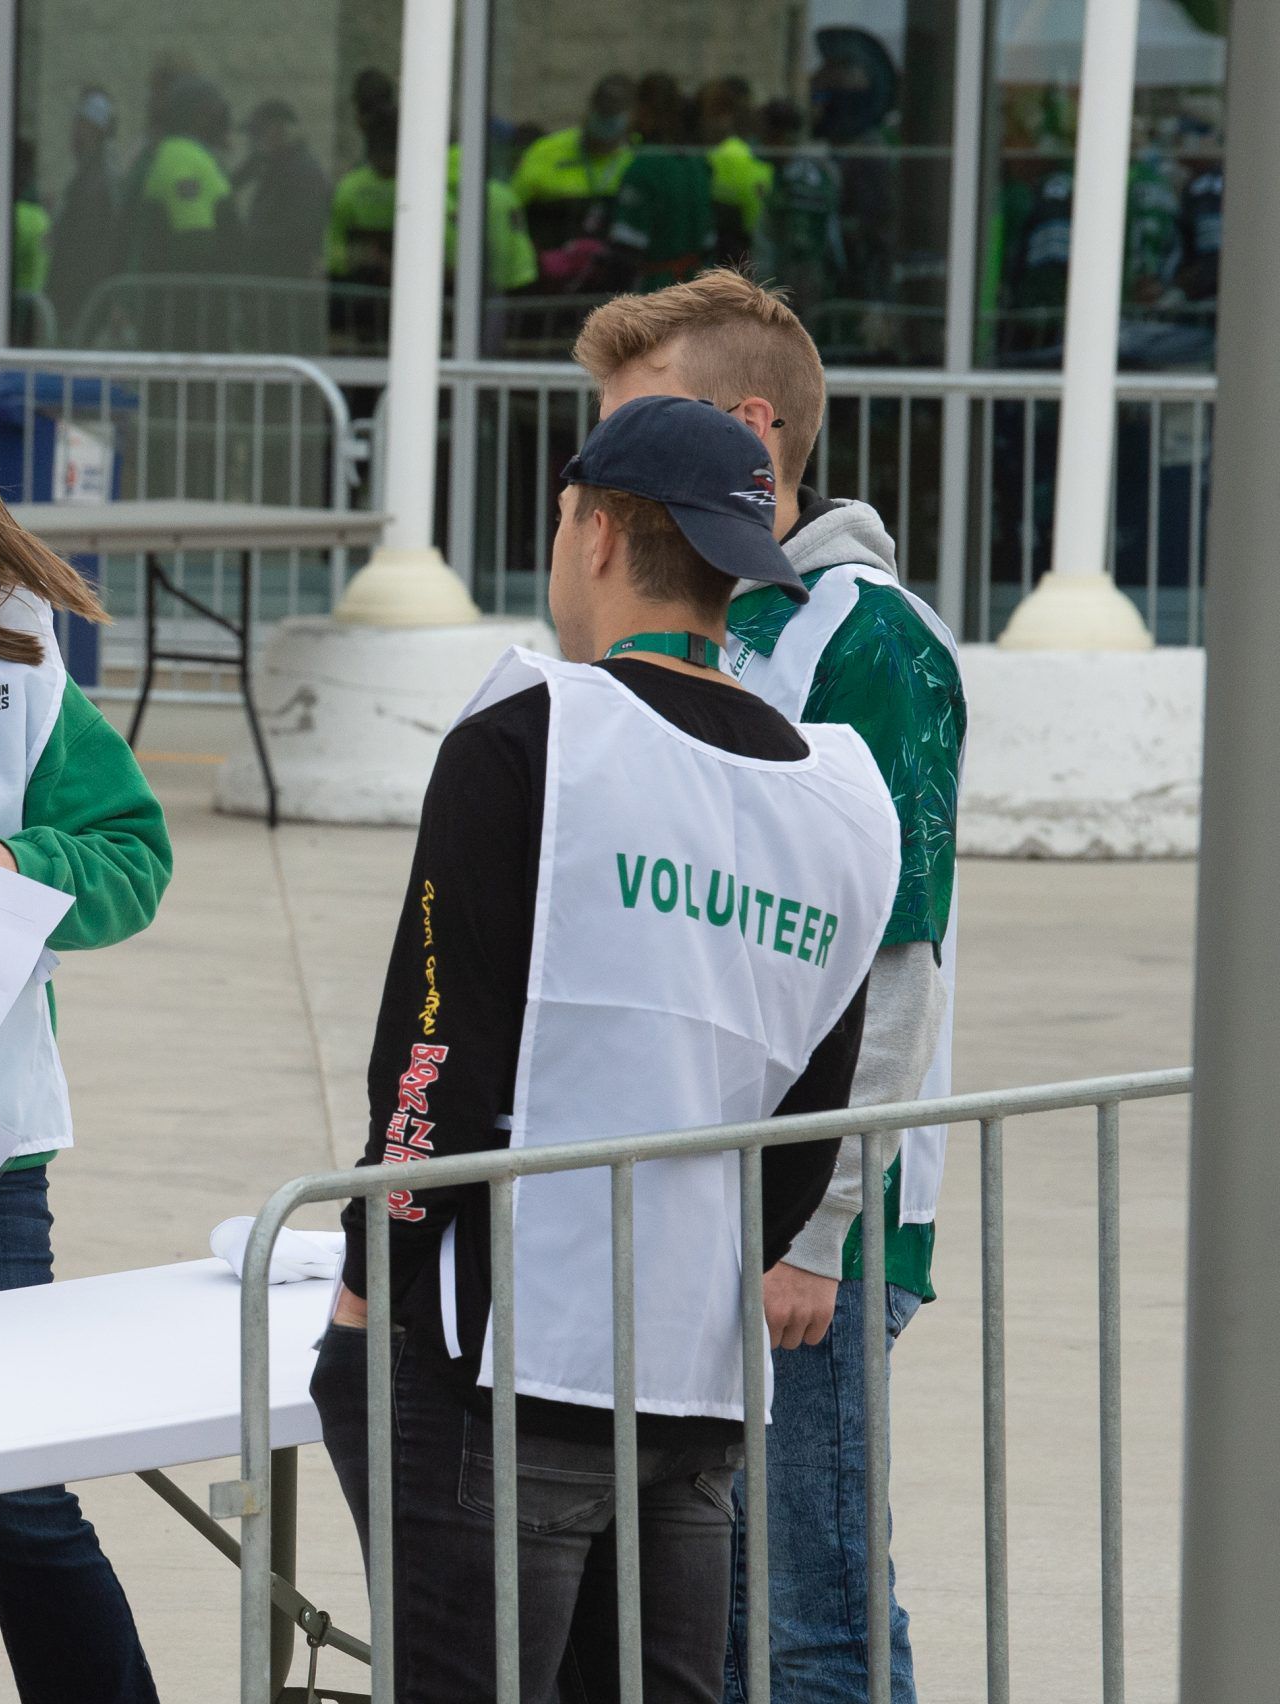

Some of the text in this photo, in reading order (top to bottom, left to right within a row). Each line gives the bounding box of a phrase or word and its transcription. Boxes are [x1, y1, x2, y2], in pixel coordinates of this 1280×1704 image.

[616, 852, 839, 970] VOLUNTEER
[386, 1113, 410, 1144] THE
[398, 1043, 449, 1150] BOYZ N
